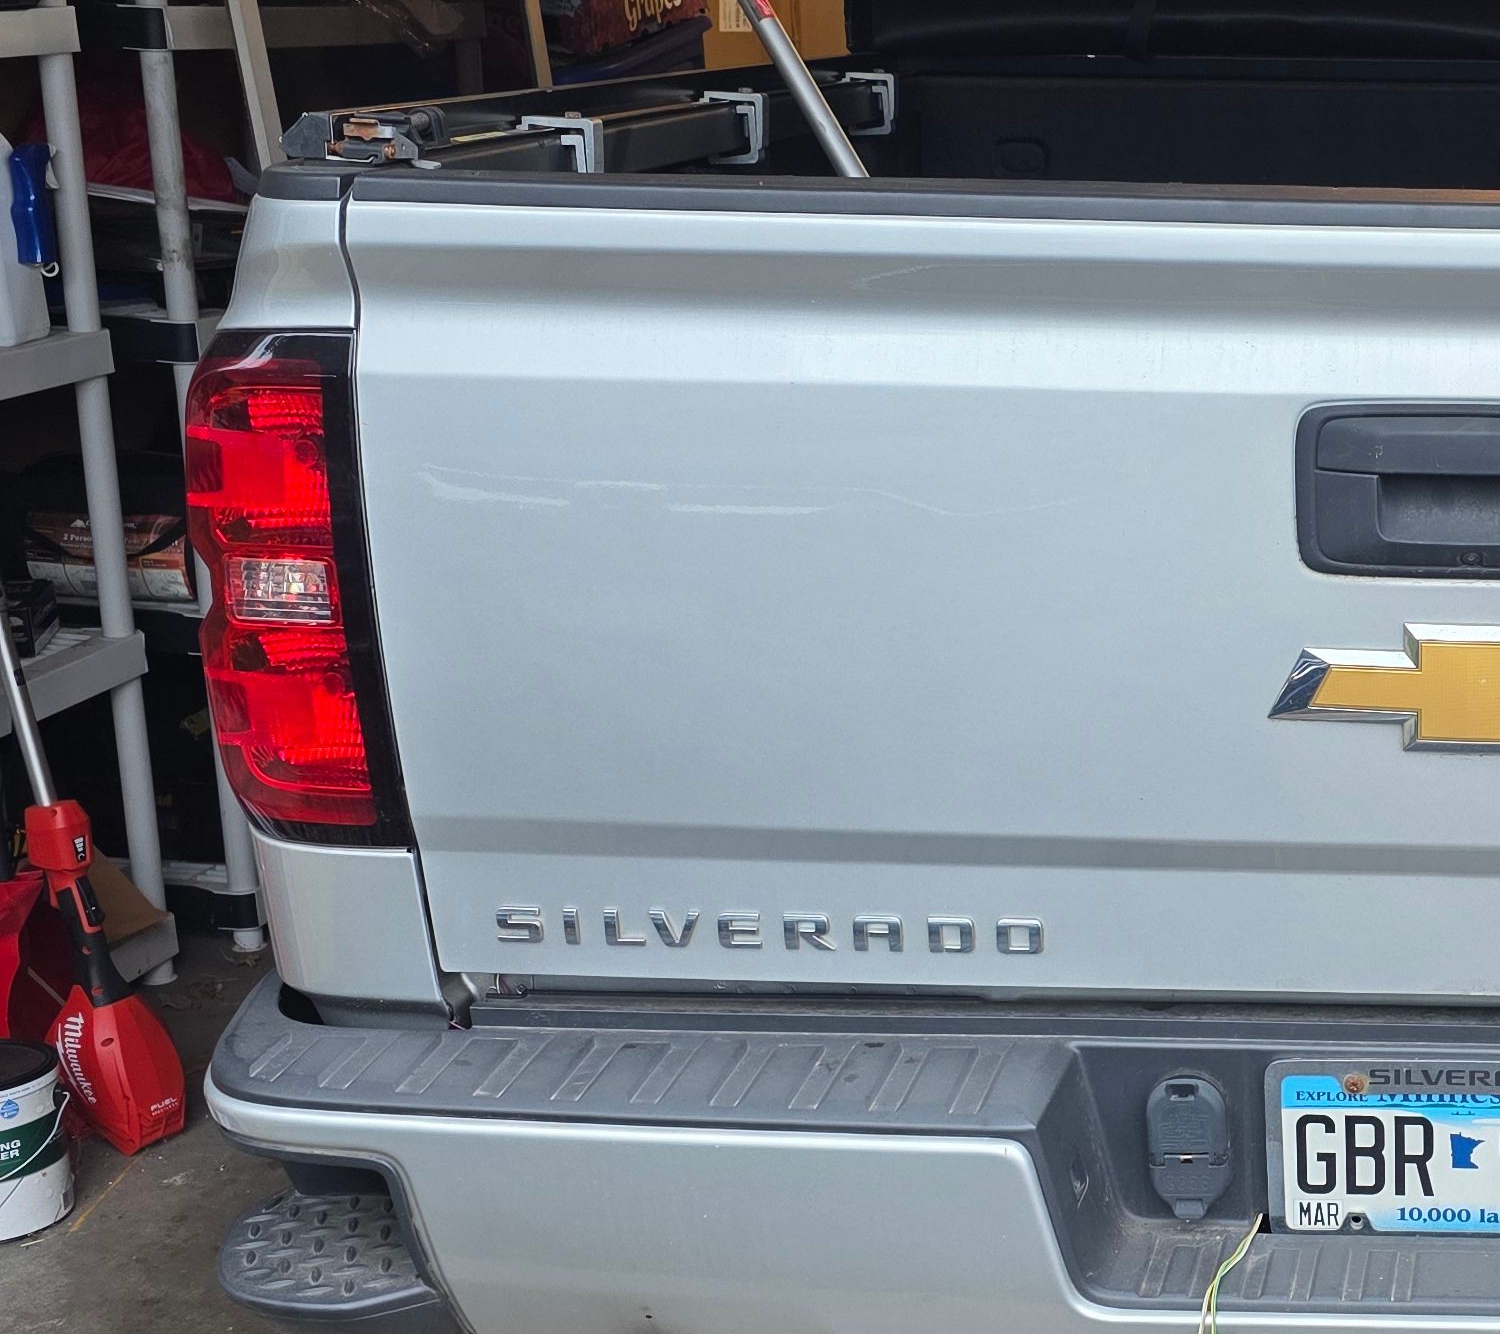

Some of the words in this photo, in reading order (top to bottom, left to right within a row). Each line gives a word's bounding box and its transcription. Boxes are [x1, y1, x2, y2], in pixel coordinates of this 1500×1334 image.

[70, 534, 93, 544] Perso
[495, 905, 1045, 955] SILVERADO
[64, 1011, 97, 1105] Milwaukee
[150, 1097, 177, 1112] FUEL
[1296, 1090, 1369, 1103] EXPLORE
[1295, 1113, 1435, 1197] GBR
[1299, 1201, 1339, 1227] MAR
[1396, 1207, 1471, 1224] 10,000
